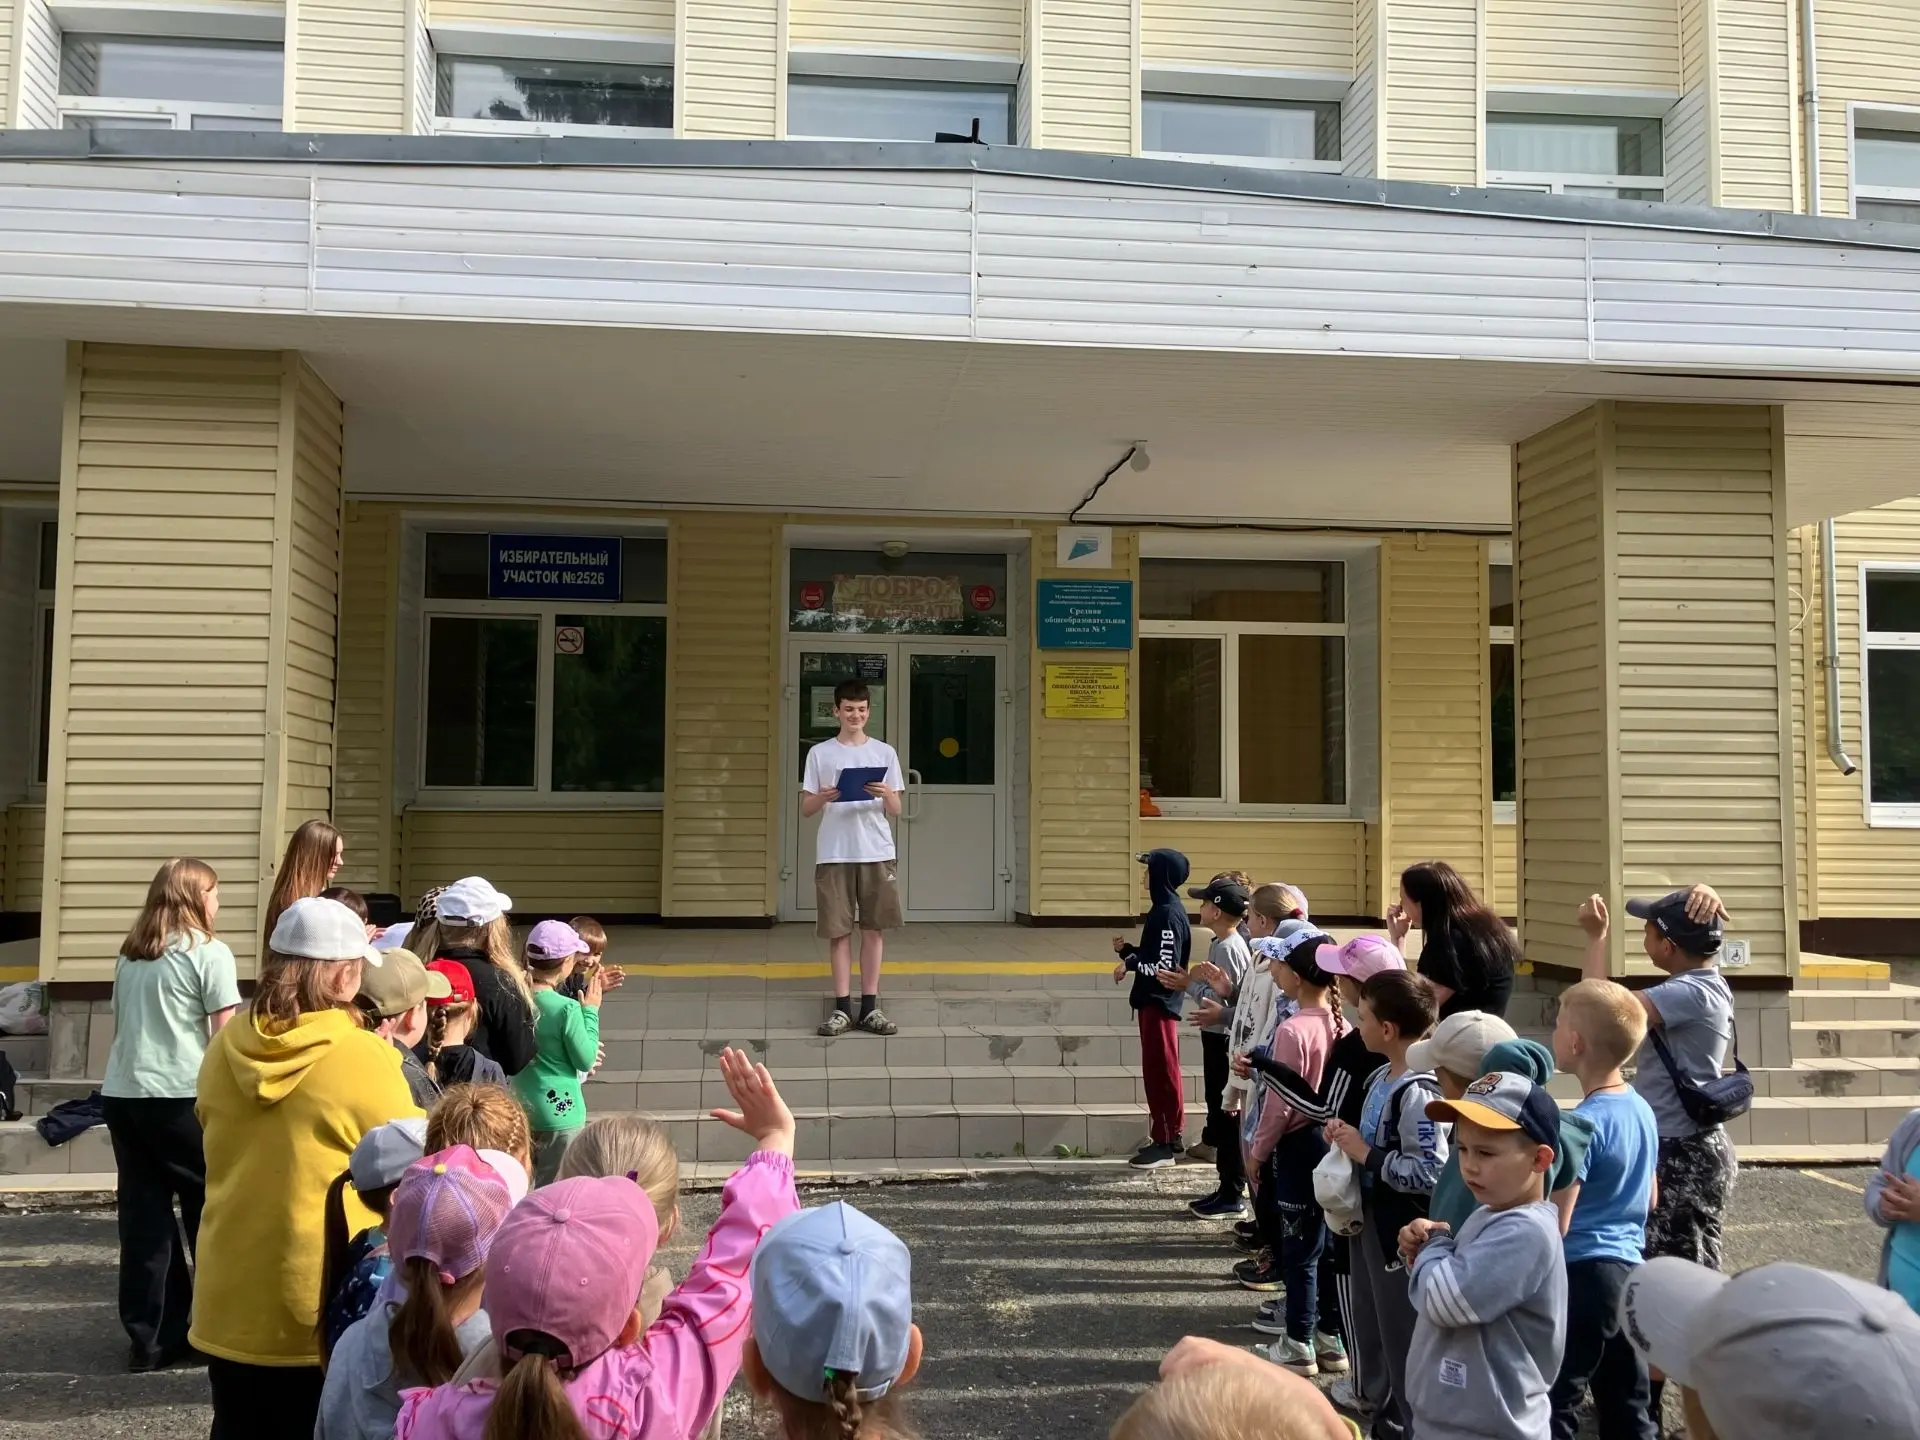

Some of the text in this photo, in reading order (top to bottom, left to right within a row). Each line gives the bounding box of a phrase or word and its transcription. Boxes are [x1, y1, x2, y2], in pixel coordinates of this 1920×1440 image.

[500, 549, 609, 566] ИЗБИРАТЕЛЬНЫЙ
[503, 569, 605, 585] УЧАСТОК №2526
[854, 576, 943, 597] ДОБРО
